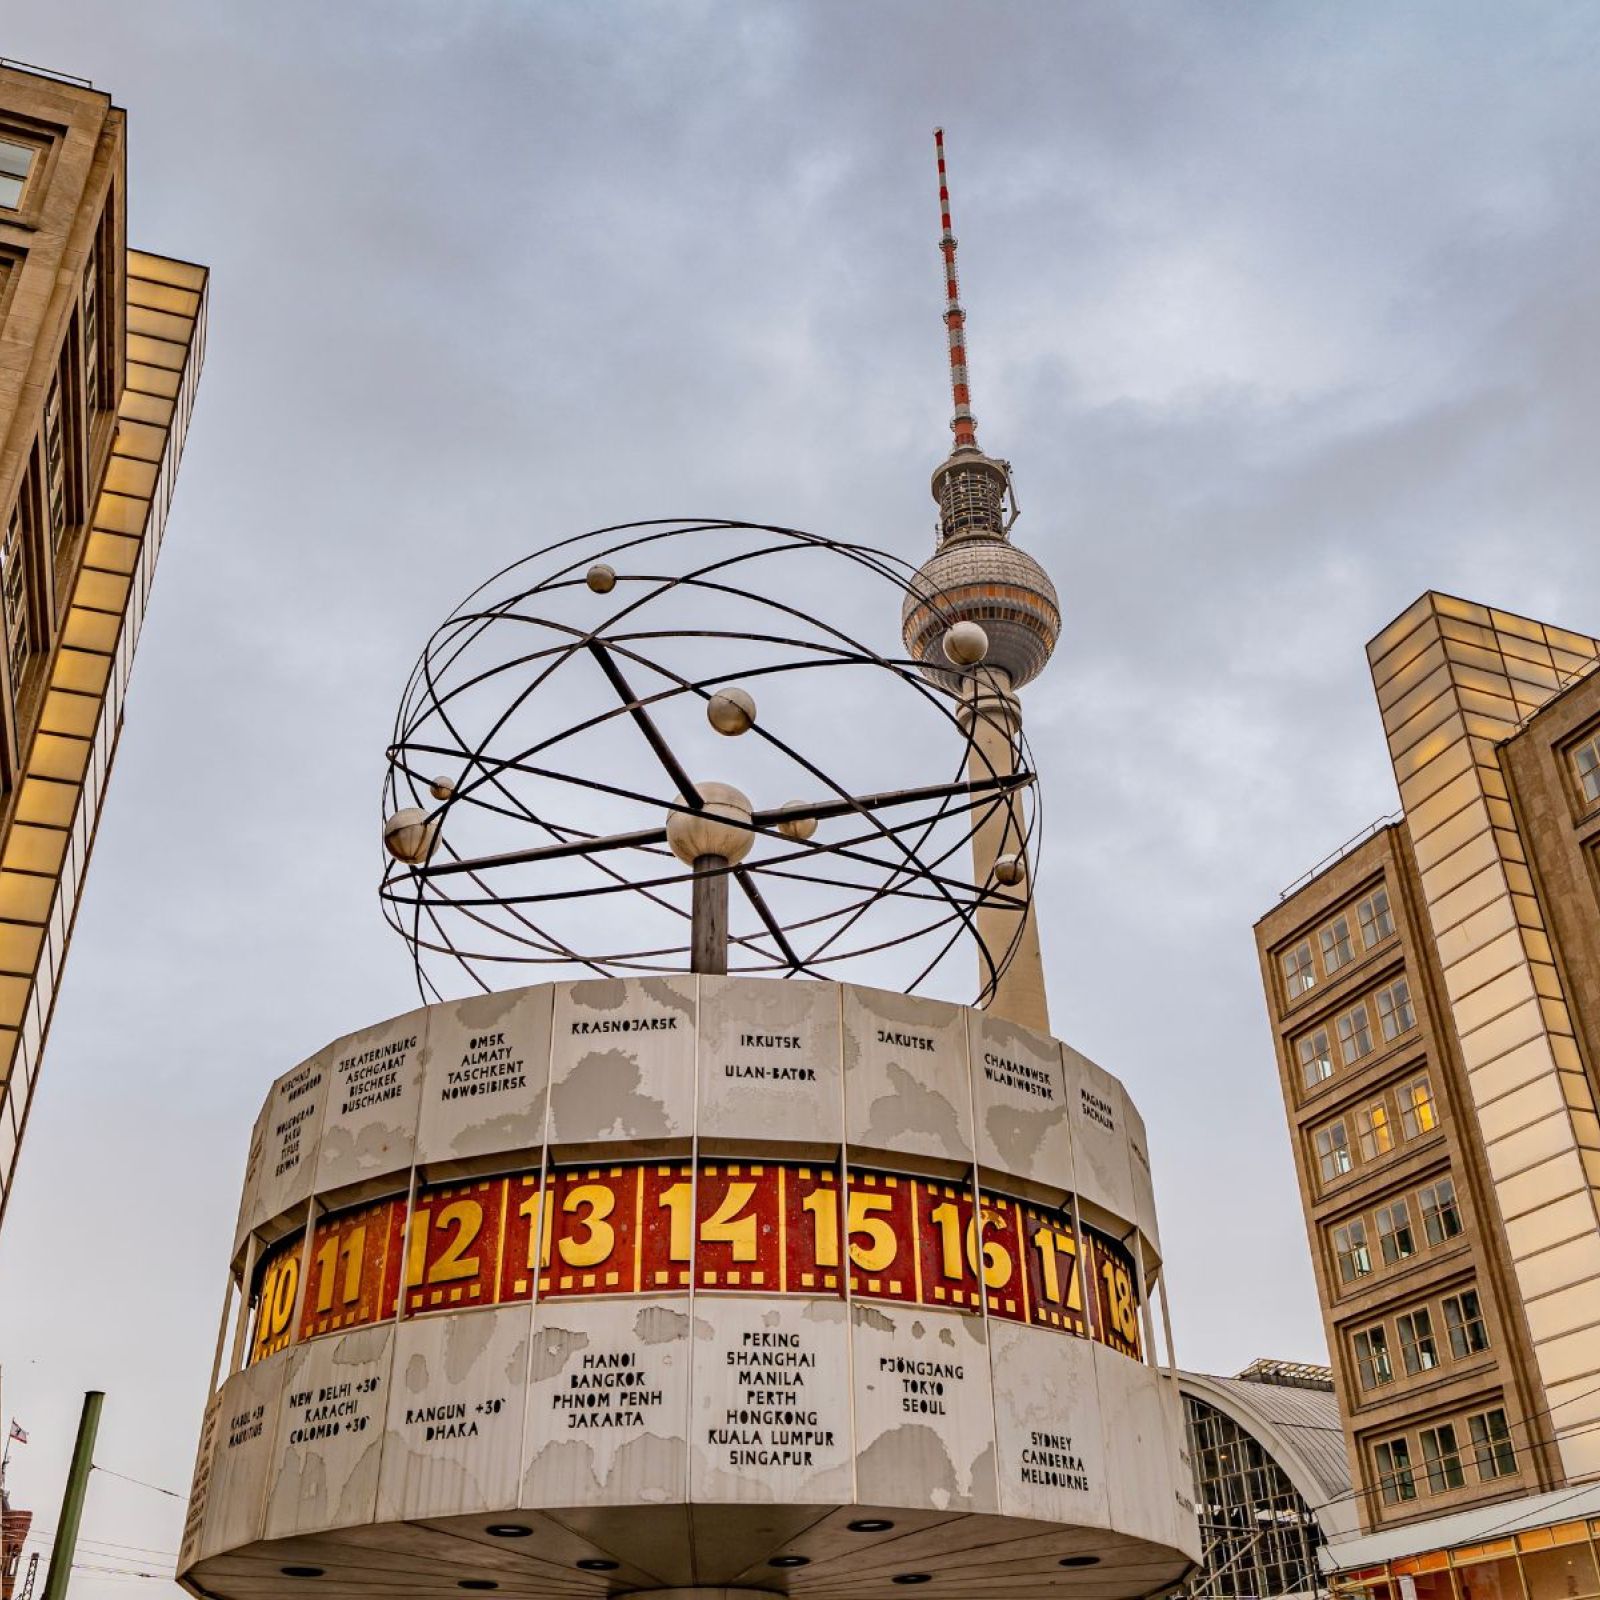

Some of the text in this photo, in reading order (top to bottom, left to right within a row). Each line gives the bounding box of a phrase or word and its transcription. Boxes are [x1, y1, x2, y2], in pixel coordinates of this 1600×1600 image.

[571, 1017, 677, 1035] KRASNOJARSK
[470, 1033, 505, 1049] OMSK
[741, 1034, 801, 1049] IRKUTSK
[877, 1030, 935, 1052] JAKUTSK
[338, 1036, 417, 1072] JEKATERINBURG
[461, 1046, 513, 1067] ALMATY
[345, 1054, 406, 1084] ASCHGABAT
[448, 1060, 524, 1084] TASCHKENT
[725, 1065, 816, 1082] ULAN-BATOR
[984, 1053, 1051, 1086] CHABAROWSK
[350, 1072, 397, 1097] BISCHKEK
[441, 1075, 526, 1101] NOWOSIBIRSK
[984, 1067, 1054, 1101] WLADIWOSTOK
[342, 1085, 402, 1115] DUSCHANBE
[259, 1182, 1136, 1344] 10 11 12 13 14 15 16 17 18
[742, 1332, 801, 1348] PEKING
[583, 1352, 636, 1369] HANOI
[726, 1351, 816, 1368] SHANGHAI
[879, 1356, 965, 1380] PJÖNGJANG
[570, 1371, 646, 1389] BANGKOK
[738, 1370, 804, 1387] MANILA
[902, 1378, 944, 1396] TOKYO
[290, 1390, 313, 1408] NEW
[319, 1383, 351, 1402] DELHI
[552, 1390, 663, 1410] PHNOM PENH
[746, 1390, 797, 1406] PERTH
[305, 1400, 358, 1423] KARACHI
[405, 1403, 466, 1425] RANGUN
[902, 1398, 946, 1416] SEOUL
[568, 1411, 644, 1429] JAKARTA
[726, 1410, 818, 1426] HONGKONG
[289, 1422, 340, 1445] COLOMBO
[426, 1421, 479, 1441] DHAKA
[708, 1429, 835, 1447] KUALA LUMPUR
[1031, 1431, 1072, 1452] SYDNEY
[729, 1450, 814, 1466] SINGAPUR
[1022, 1449, 1085, 1472] CANBERRA
[1021, 1467, 1090, 1492] MELBOURNE
